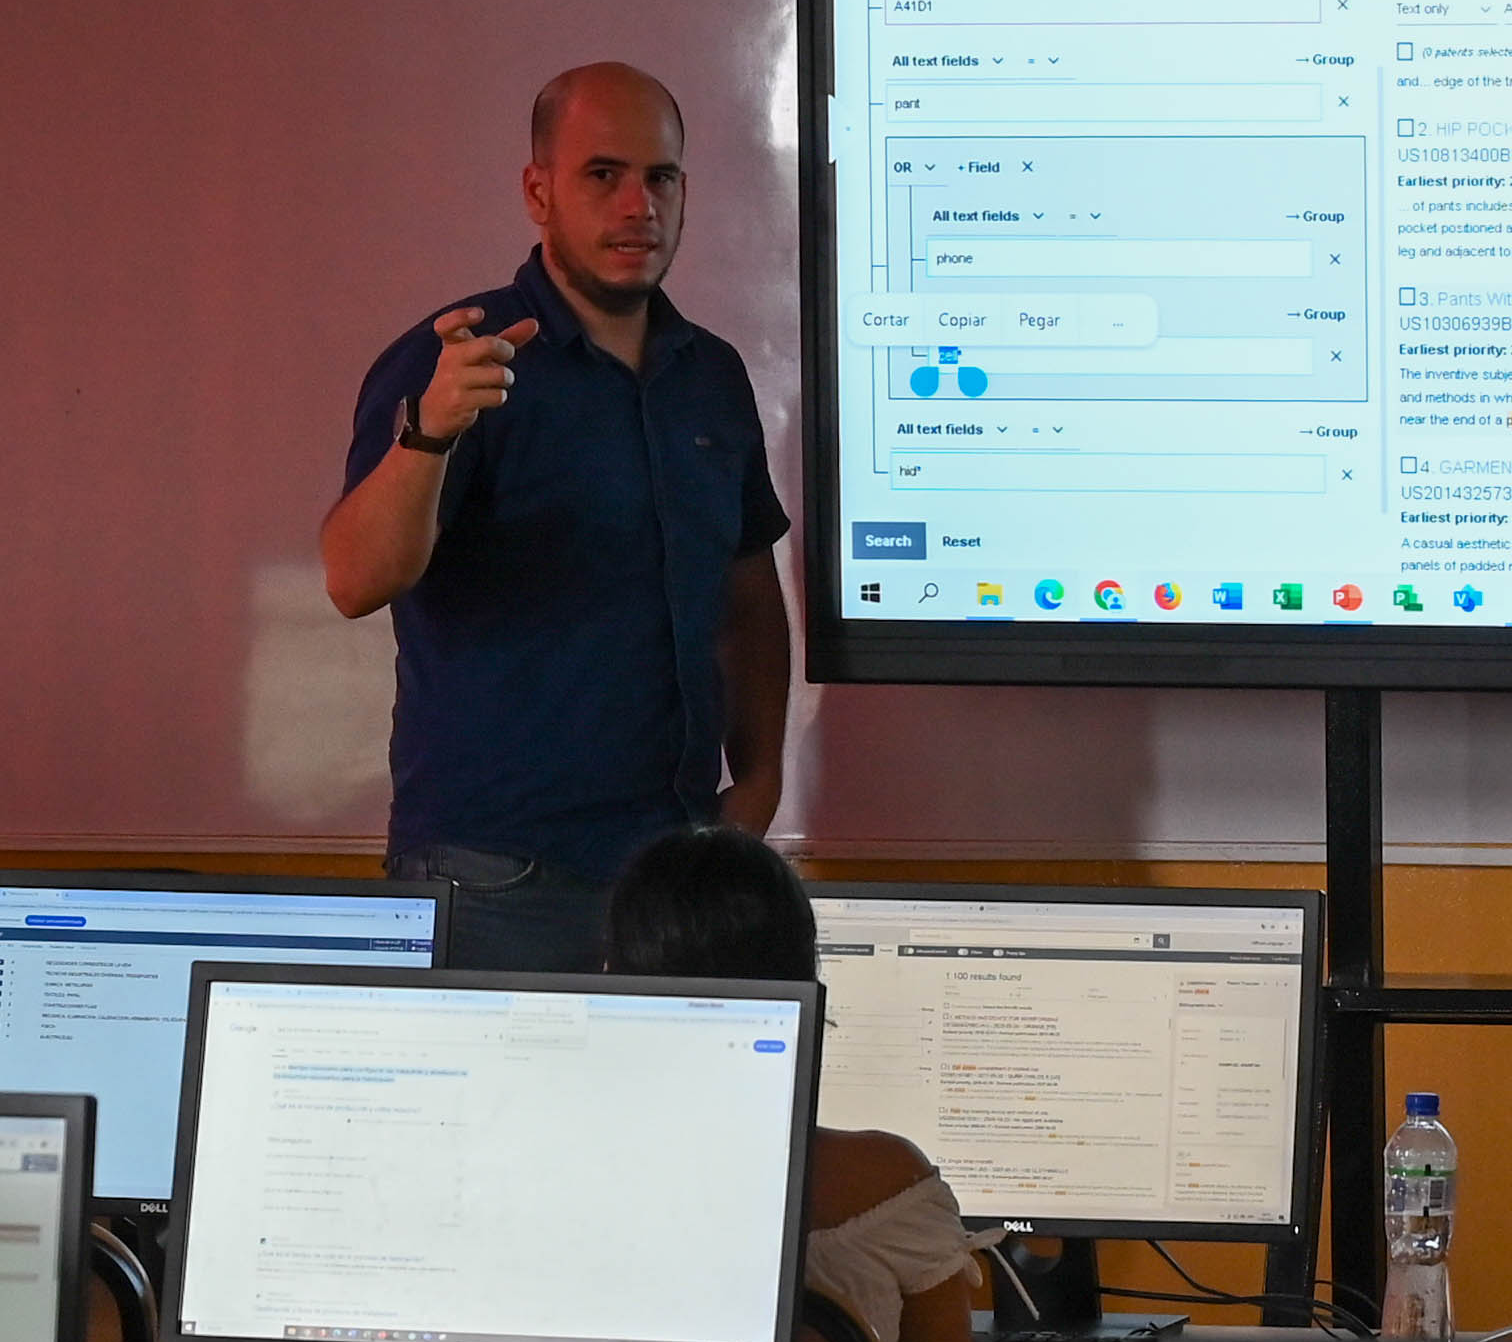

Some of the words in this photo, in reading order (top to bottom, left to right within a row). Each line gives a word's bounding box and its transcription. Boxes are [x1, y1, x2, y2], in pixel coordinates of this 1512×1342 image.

[893, 0, 932, 12] A41D1
[1396, 2, 1421, 15] Text
[1424, 2, 1450, 17] only
[892, 55, 909, 67] All
[912, 56, 938, 67] text
[941, 55, 980, 67] fields
[1312, 53, 1355, 68] Group
[894, 98, 921, 112] pant
[1436, 121, 1462, 137] HIP
[893, 161, 913, 173] OR
[968, 161, 1001, 173] Field
[933, 210, 950, 222] All
[953, 210, 979, 222] text
[982, 210, 1020, 222] fields
[1303, 210, 1345, 225] Group
[936, 253, 973, 266] phone
[1437, 291, 1482, 307] Pants
[862, 311, 910, 327] Cortar
[938, 312, 987, 330] Copiar
[1019, 312, 1061, 331] Pegar
[1303, 308, 1346, 323] Group
[1316, 425, 1358, 440] Group
[865, 534, 912, 547] Search
[942, 535, 981, 548] Reset
[970, 973, 996, 981] results
[999, 973, 1022, 981] found
[140, 1202, 168, 1214] DELL
[1003, 1220, 1034, 1233] DELL
